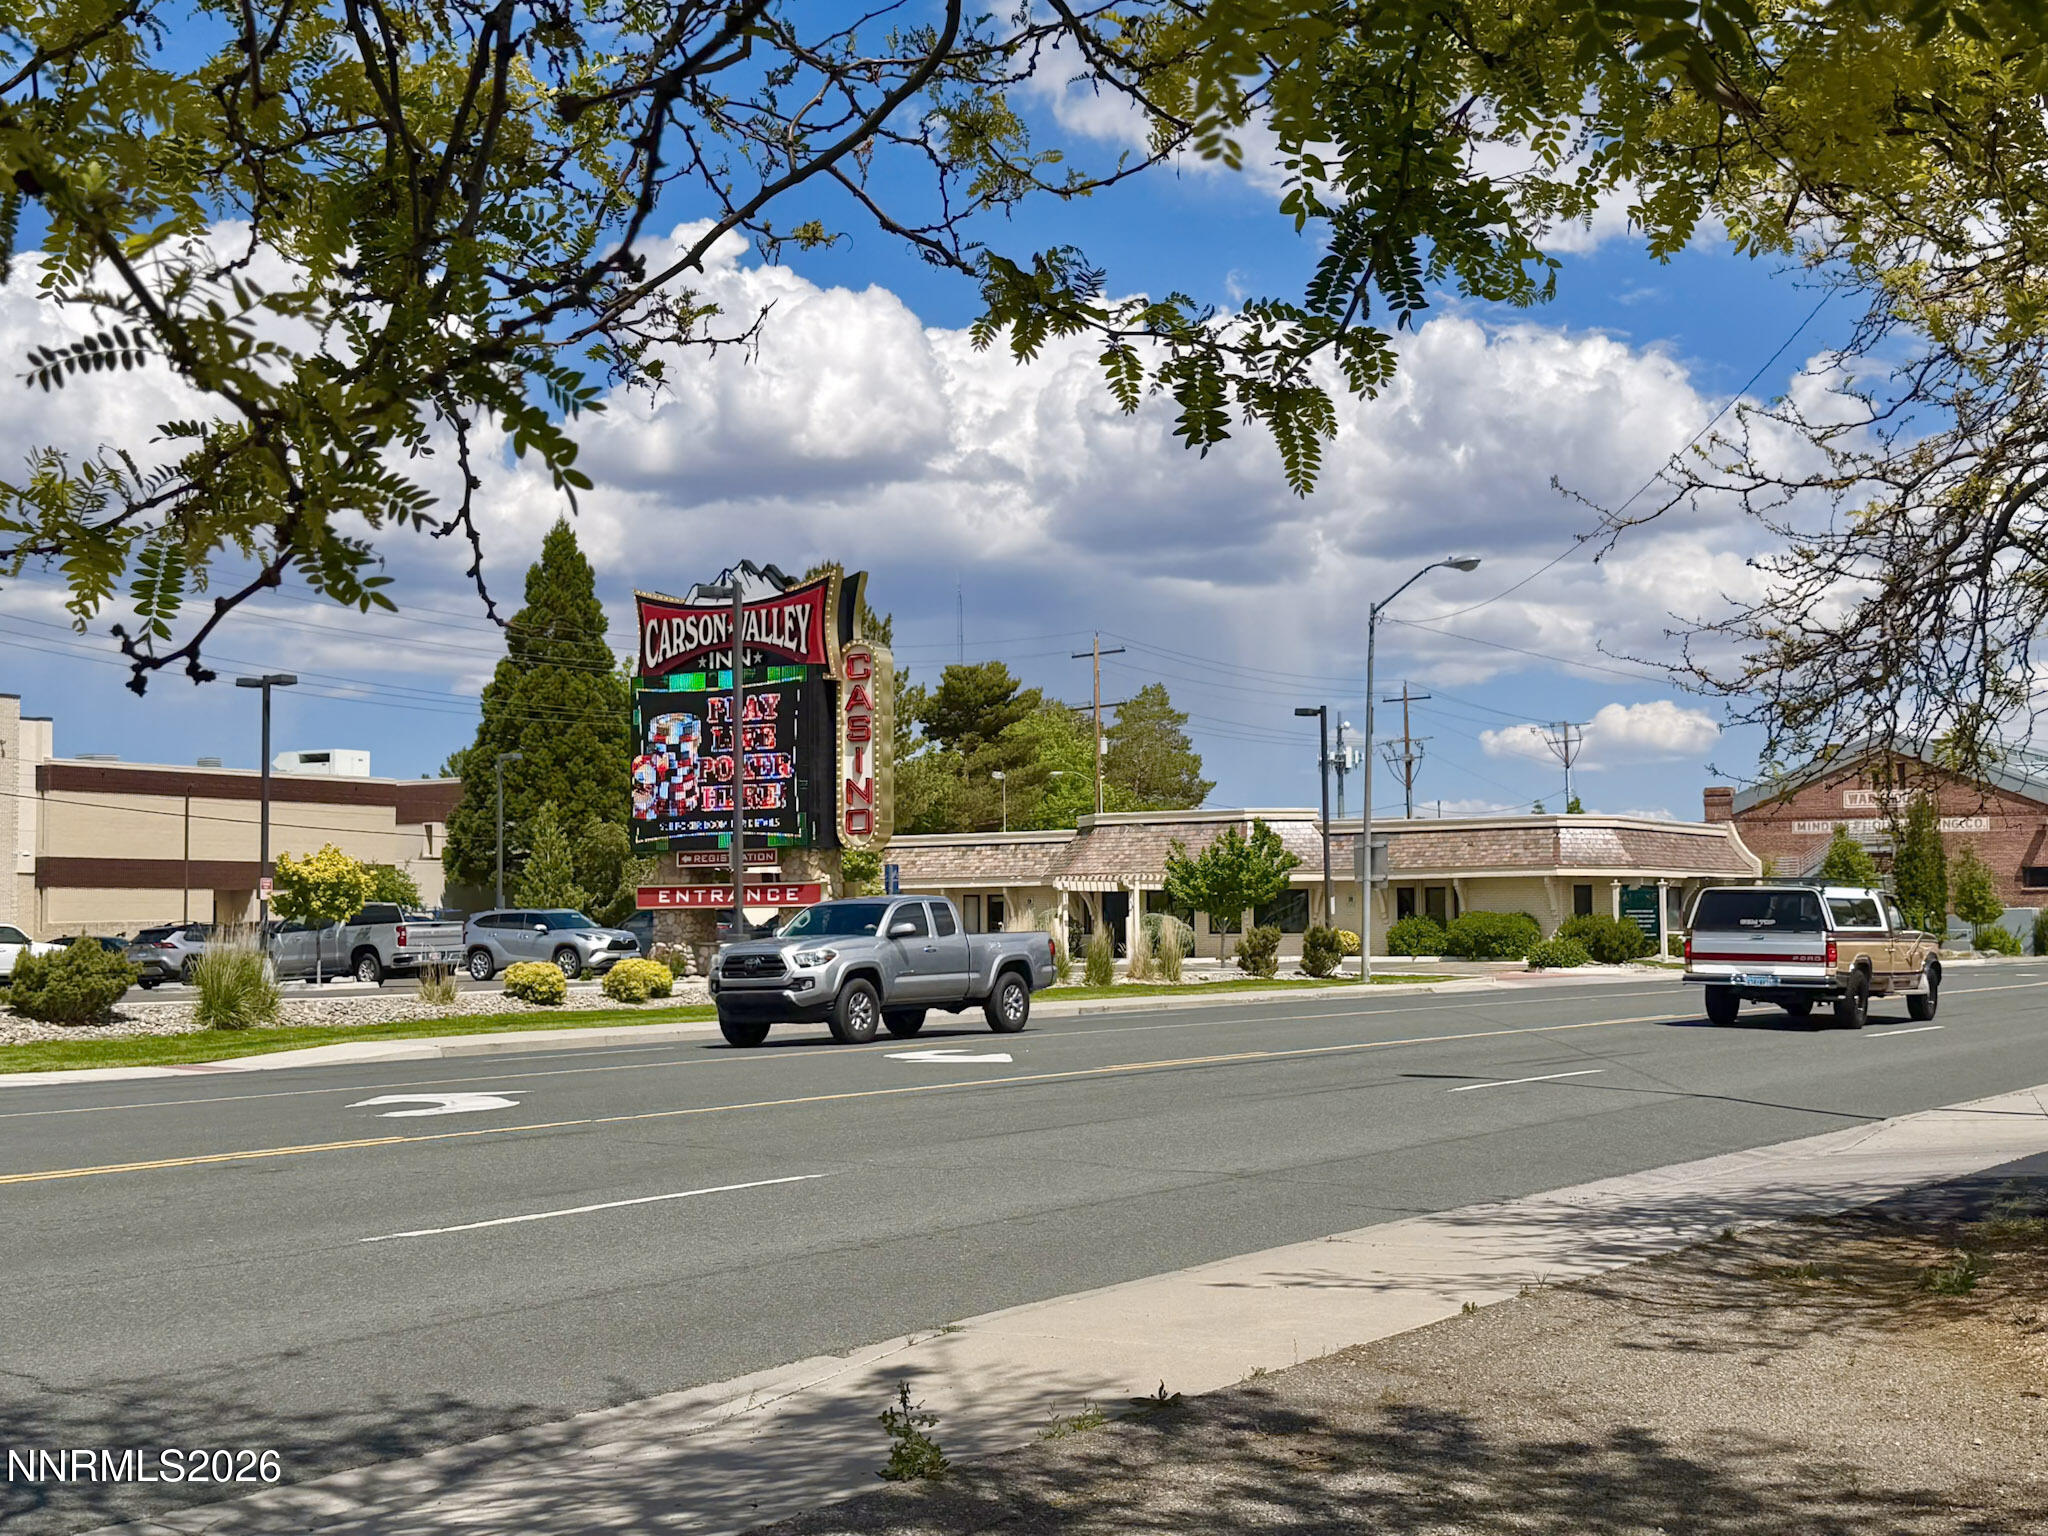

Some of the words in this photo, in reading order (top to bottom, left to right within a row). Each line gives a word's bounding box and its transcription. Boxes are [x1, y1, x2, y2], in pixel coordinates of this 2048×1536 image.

[645, 613, 728, 668] CARSON
[845, 653, 873, 835] CASINO
[693, 851, 774, 863] REGISATION
